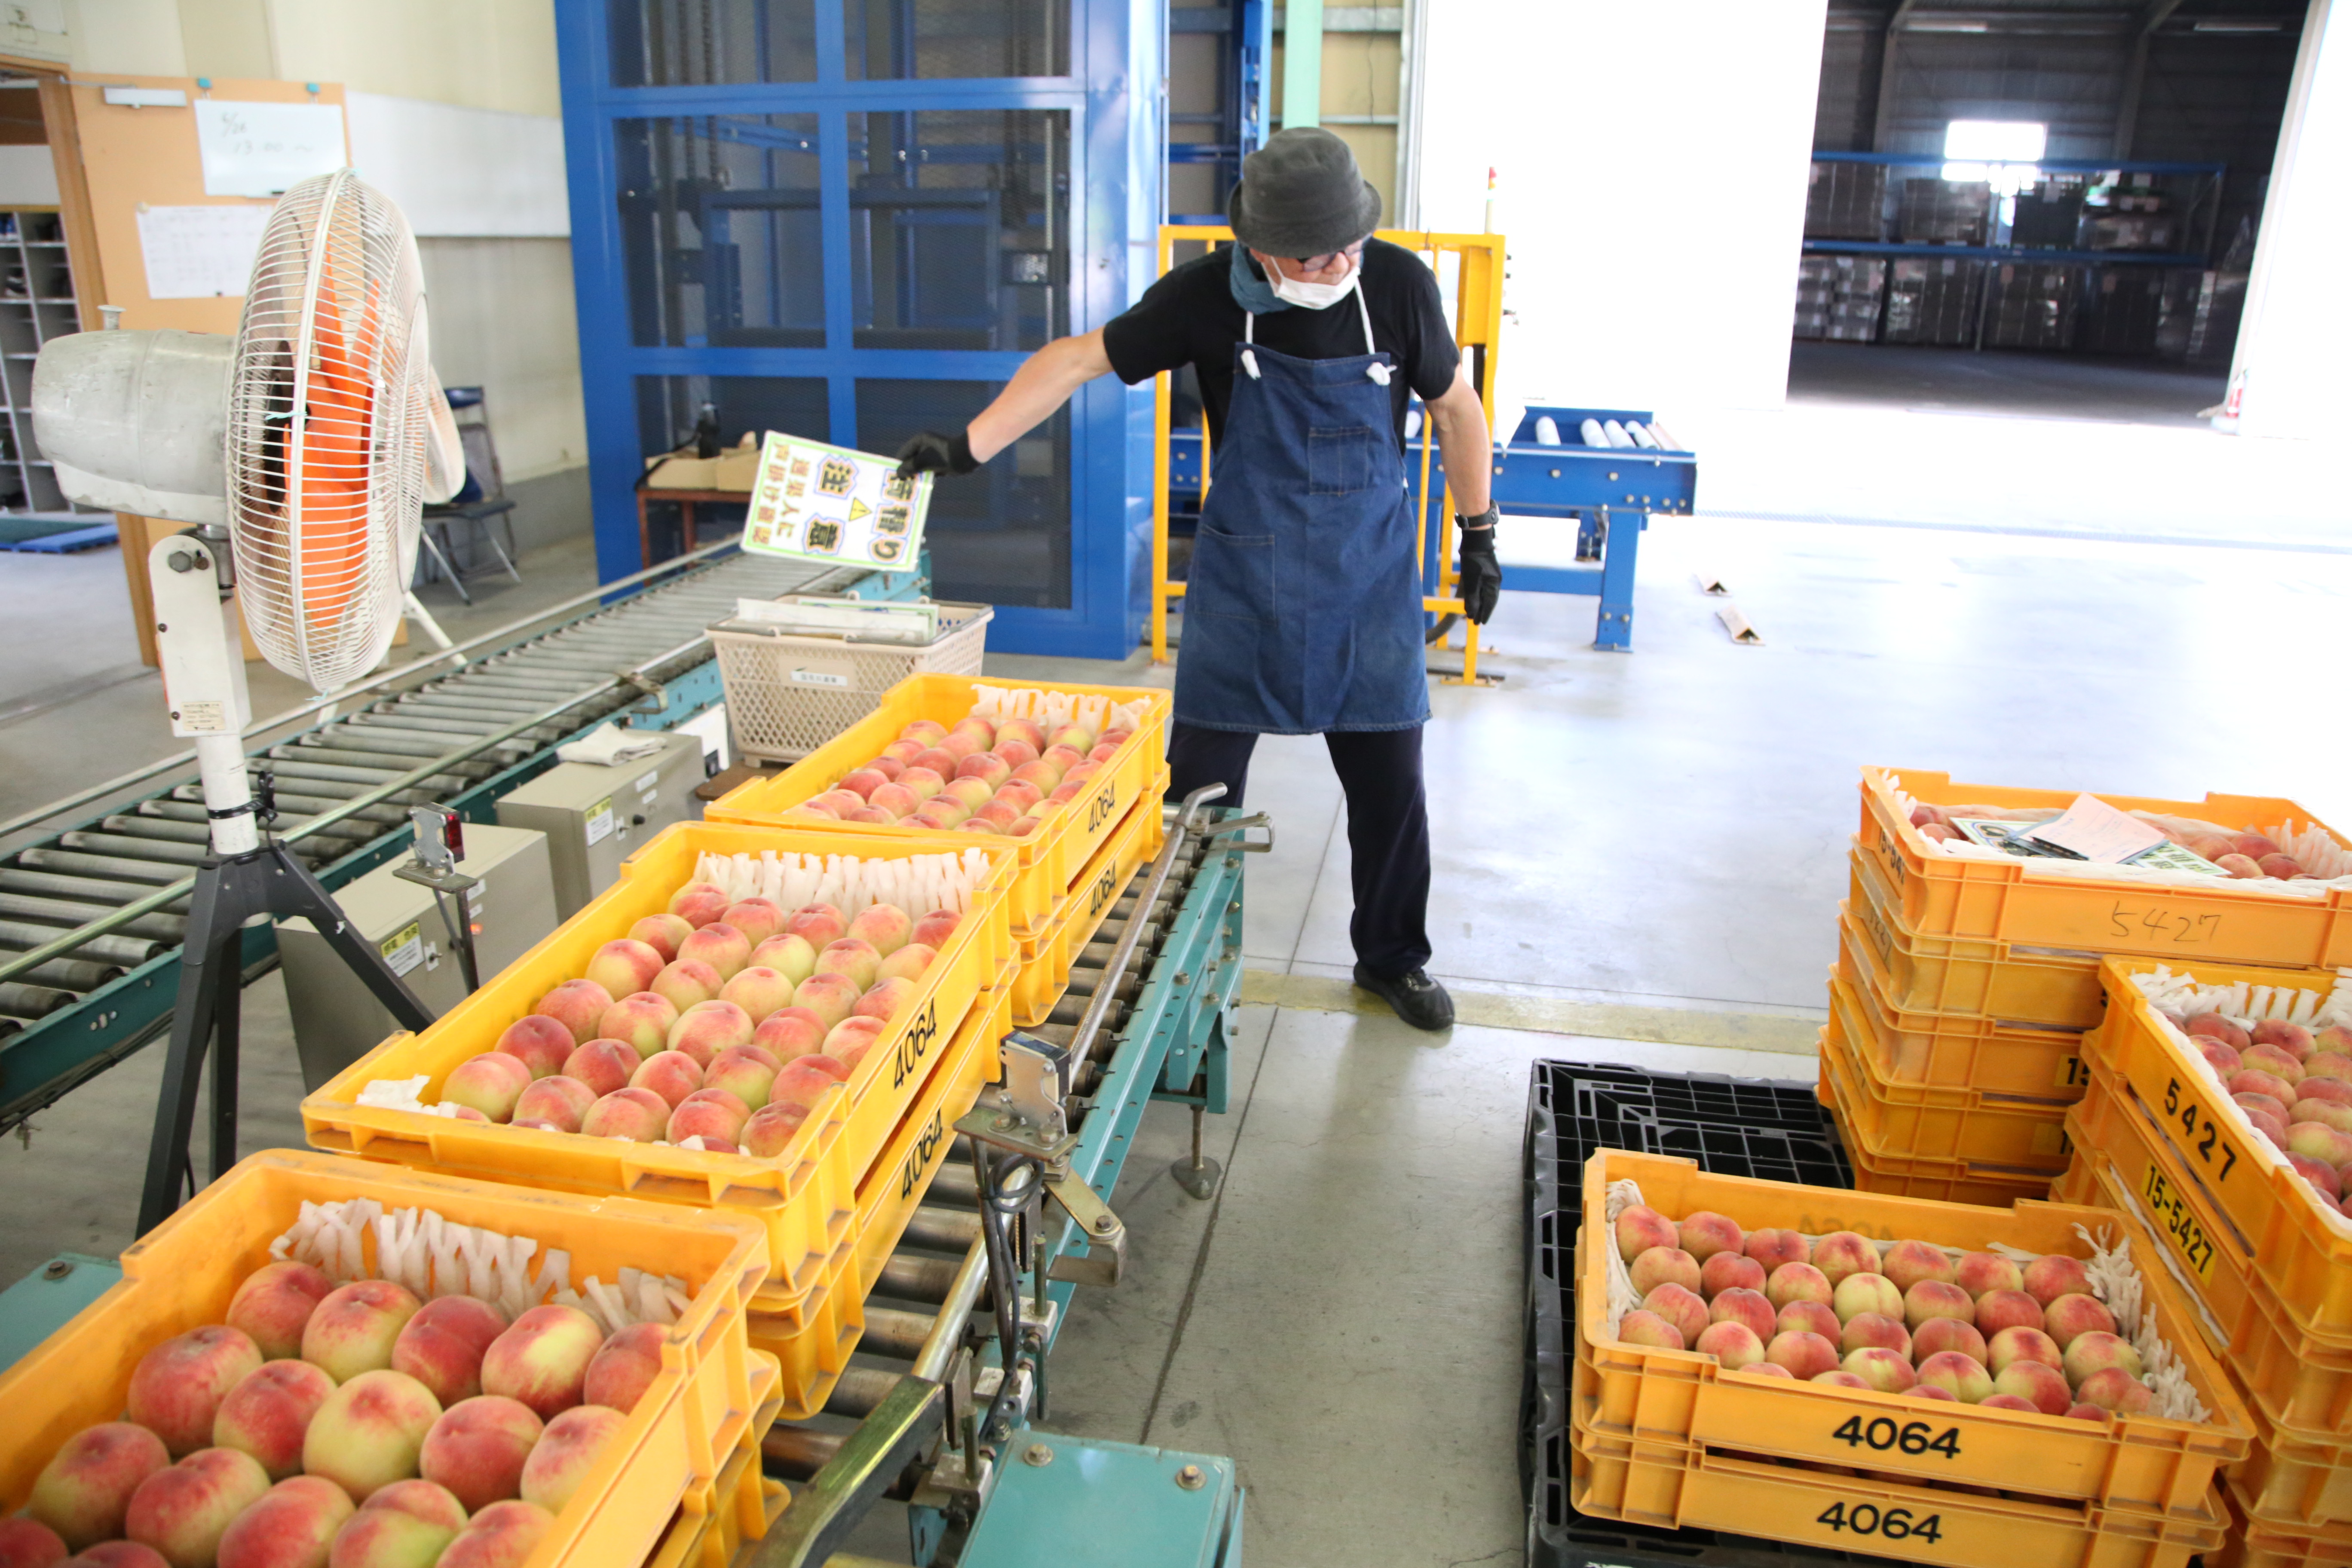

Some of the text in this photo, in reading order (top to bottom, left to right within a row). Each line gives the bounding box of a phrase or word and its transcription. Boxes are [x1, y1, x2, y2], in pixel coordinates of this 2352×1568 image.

[808, 461, 853, 551] 注意
[1088, 781, 1116, 833] 4064
[1090, 860, 1118, 917] 4064
[2110, 900, 2221, 943] 5427
[893, 996, 937, 1090] 4064
[901, 1108, 943, 1200] 4064
[2164, 1077, 2237, 1182] 5427
[2144, 1164, 2214, 1275] 15-5427
[1832, 1415, 1962, 1460] 4064
[1816, 1501, 1943, 1545] 4064
